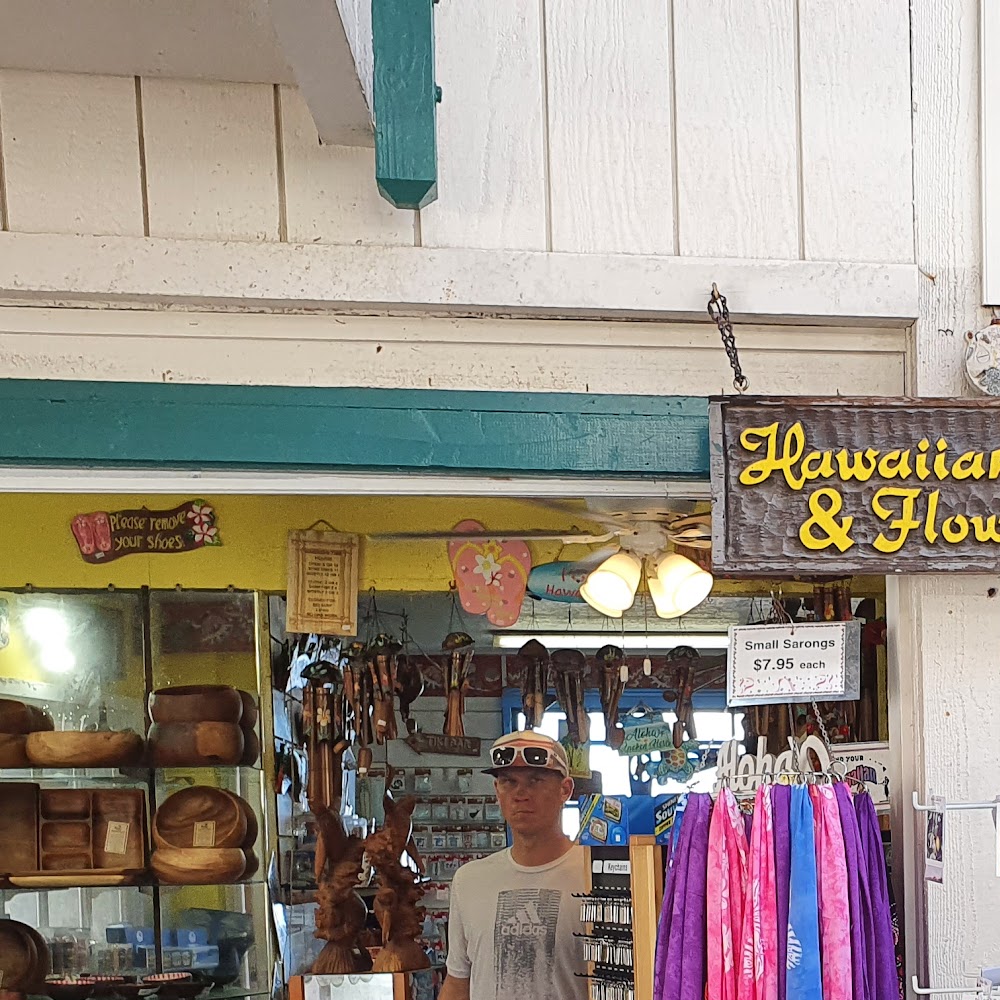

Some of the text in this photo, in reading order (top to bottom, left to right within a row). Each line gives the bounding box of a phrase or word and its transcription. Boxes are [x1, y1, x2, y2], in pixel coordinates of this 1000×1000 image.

[110, 511, 186, 531] Please remove
[799, 488, 855, 553] &
[115, 535, 142, 550] your
[546, 584, 581, 598] Hawa
[745, 639, 835, 650] Small Sarongs
[753, 658, 825, 672] $7.95 each
[502, 923, 547, 936] adidas
